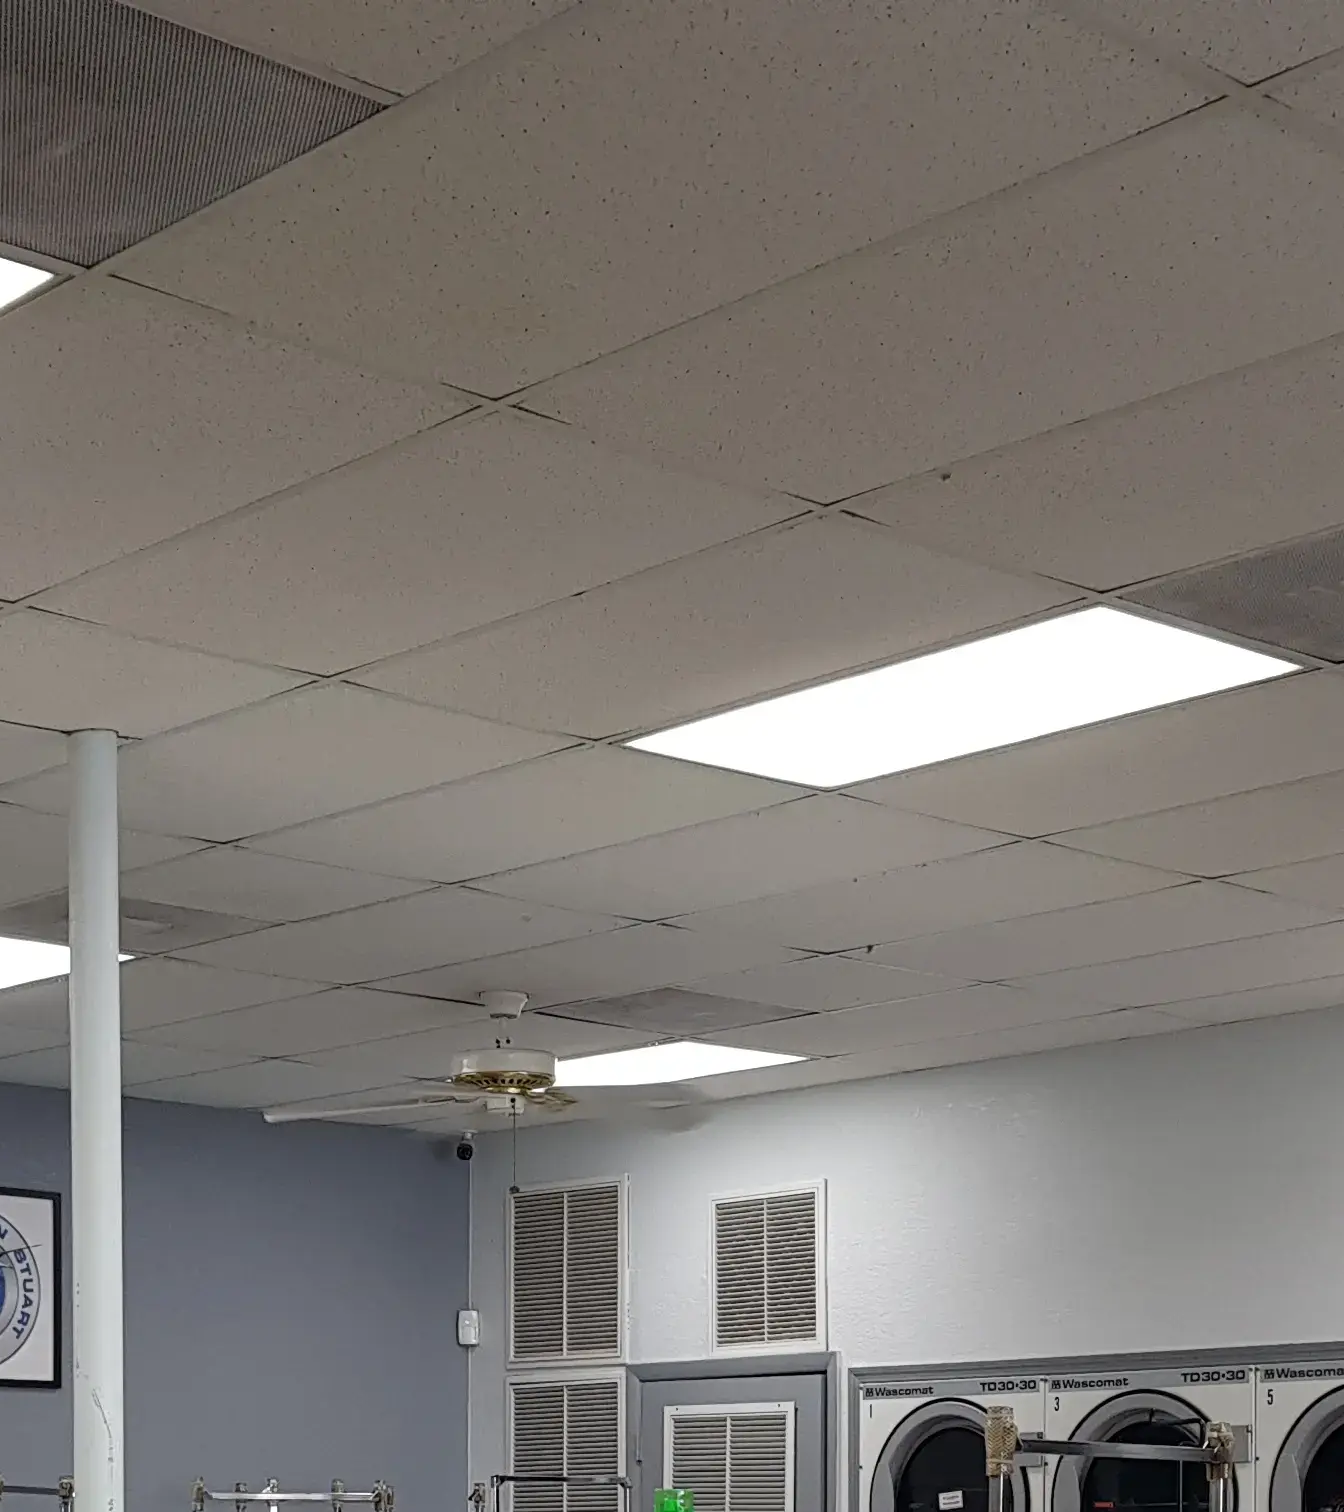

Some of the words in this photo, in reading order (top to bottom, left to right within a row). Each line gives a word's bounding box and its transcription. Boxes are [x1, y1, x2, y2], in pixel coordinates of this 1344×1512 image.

[1062, 1377, 1129, 1389] Wascomat
[875, 1386, 934, 1397] Wascomat
[1267, 1388, 1274, 1405] 5
[1054, 1397, 1060, 1412] 3
